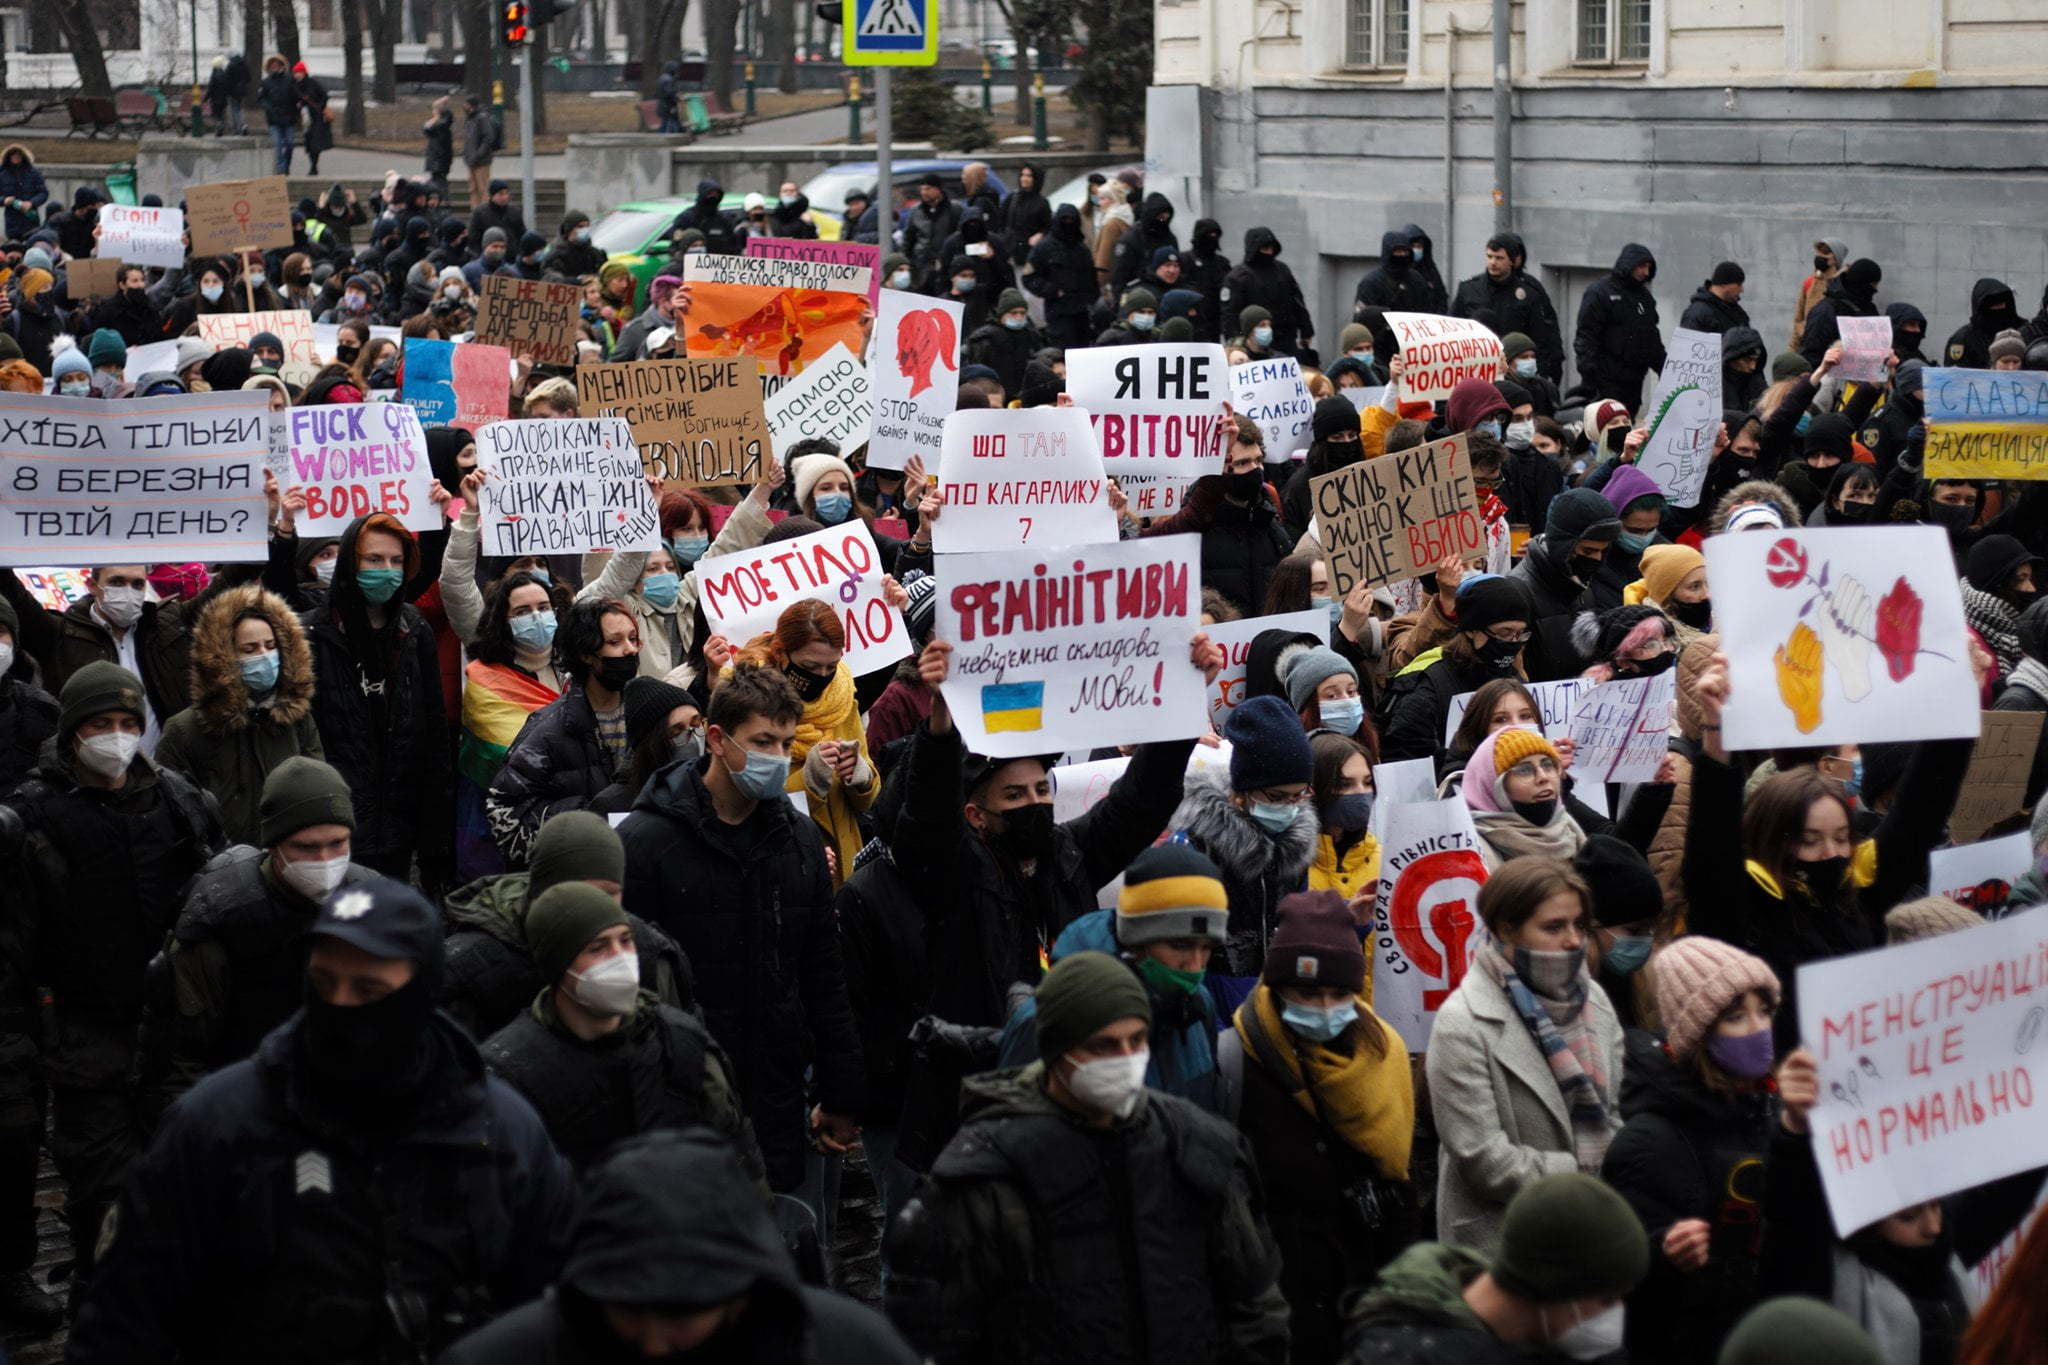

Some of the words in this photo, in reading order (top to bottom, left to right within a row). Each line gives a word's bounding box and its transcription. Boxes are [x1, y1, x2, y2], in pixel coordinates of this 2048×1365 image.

[694, 254, 766, 273] ДОМОГЛИСЯ
[772, 260, 809, 277] ПРАВО
[813, 263, 860, 280] ГОЛОСУ
[800, 277, 828, 291] ТОГО
[486, 277, 509, 297] ЦЕ
[516, 281, 538, 300] НЕ
[545, 285, 578, 306] МОЯ
[485, 318, 518, 339] АЛЕ
[528, 320, 538, 340] Я
[1398, 321, 1416, 342] Я
[1412, 319, 1437, 338] НЕ
[1404, 338, 1500, 371] ДОГОДЖАТИ
[1114, 357, 1141, 400] Я
[1157, 355, 1211, 401] НЕ
[879, 398, 918, 422] STOP
[1940, 380, 2048, 417] СЛАВА
[122, 416, 263, 449] ТІЛЬКИ
[292, 406, 368, 446] FUCK
[383, 404, 417, 442] OFF
[1090, 414, 1225, 459] ВІТОЧКА
[290, 439, 417, 483] WOMEN'S
[637, 436, 763, 484] ЕВОЛЮЦІЯ
[1018, 431, 1067, 457] ТАМ
[13, 466, 39, 491] 8
[57, 463, 251, 493] БЕРЕЗНЯ
[944, 483, 978, 506] ПО
[987, 479, 1101, 506] КАГАРЛИКУ
[1137, 488, 1157, 511] НЕ
[15, 505, 113, 537] ТВІЙ
[126, 509, 250, 540] ДЕНЬ?
[1019, 517, 1032, 544] ?
[1407, 510, 1479, 569] ВБИТО
[1331, 533, 1402, 596] БУДЕ
[950, 559, 1188, 643] ФЕМІНІТИВИ
[1066, 626, 1161, 668] складова
[1908, 1024, 1965, 1078] ЦЕ
[1829, 1066, 2034, 1175] НОРМАЛЬНО
